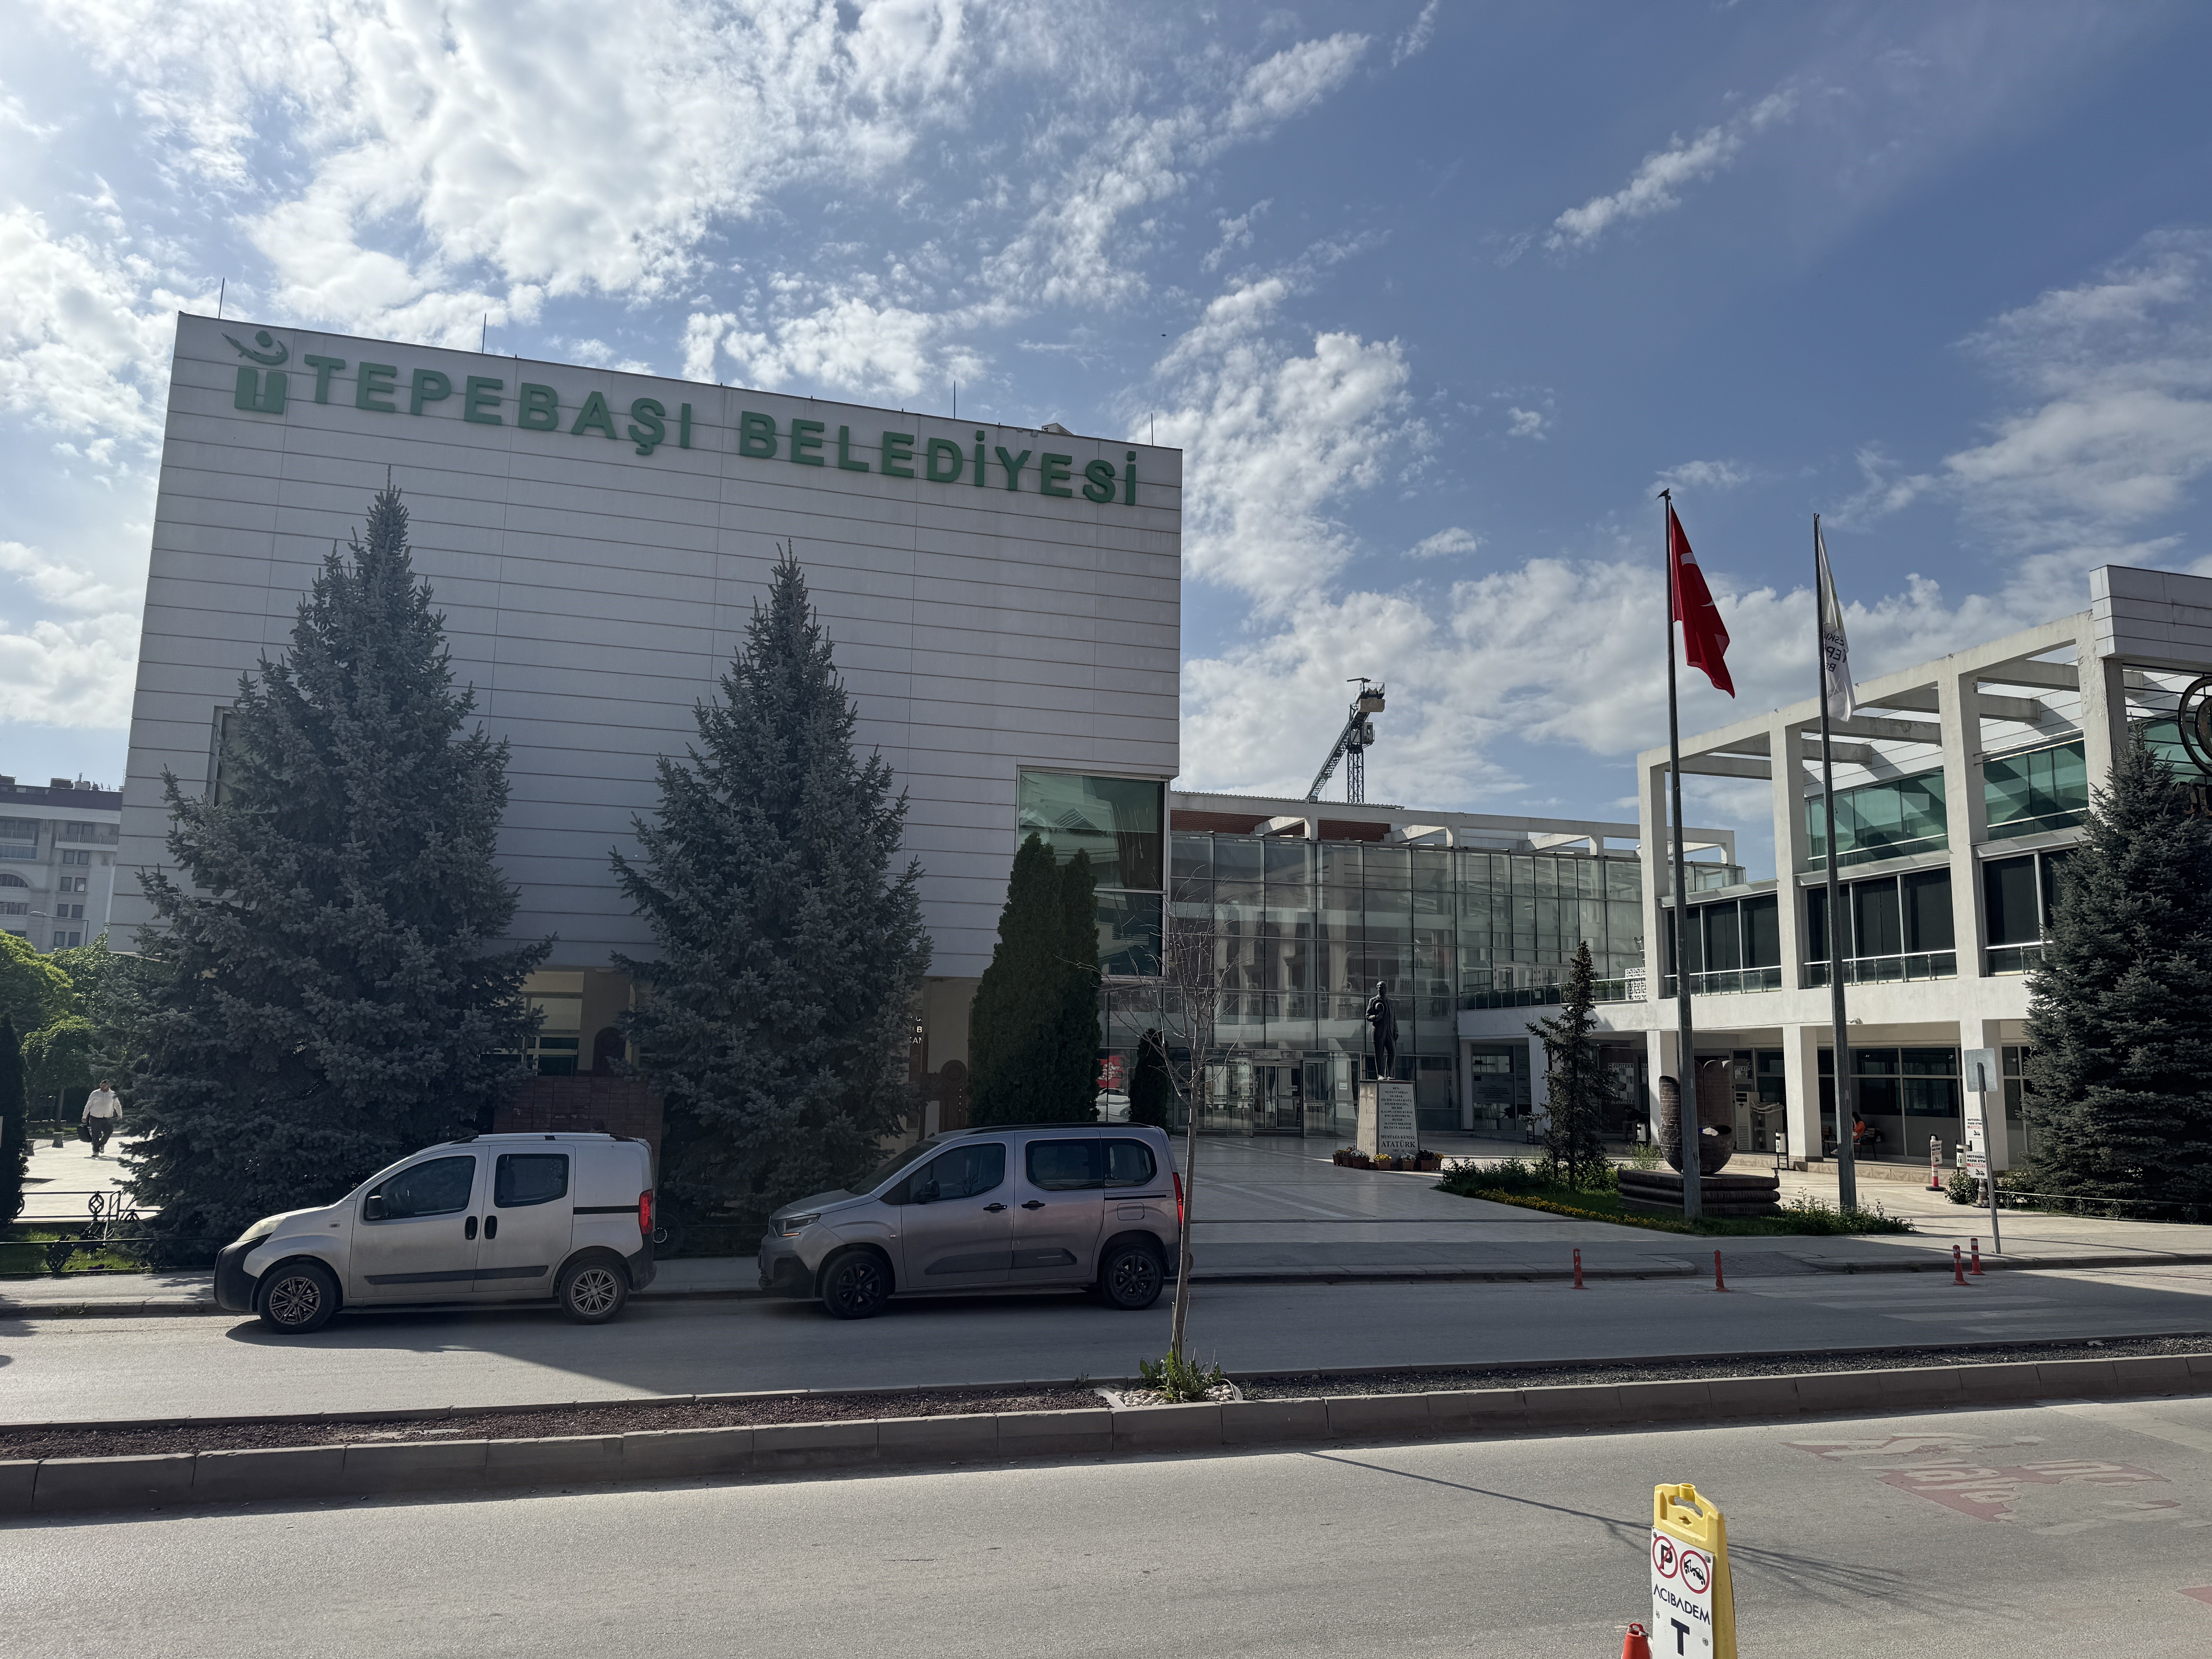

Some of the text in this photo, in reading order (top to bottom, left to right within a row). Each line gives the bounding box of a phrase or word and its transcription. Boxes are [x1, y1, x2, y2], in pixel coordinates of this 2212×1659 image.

[304, 353, 1137, 506] TEPEBAŞI BELEDİYESİ
[1381, 1140, 1416, 1148] ATATÜRK
[1653, 1583, 1711, 1625] ACIBADEM
[1671, 1617, 1690, 1657] T
